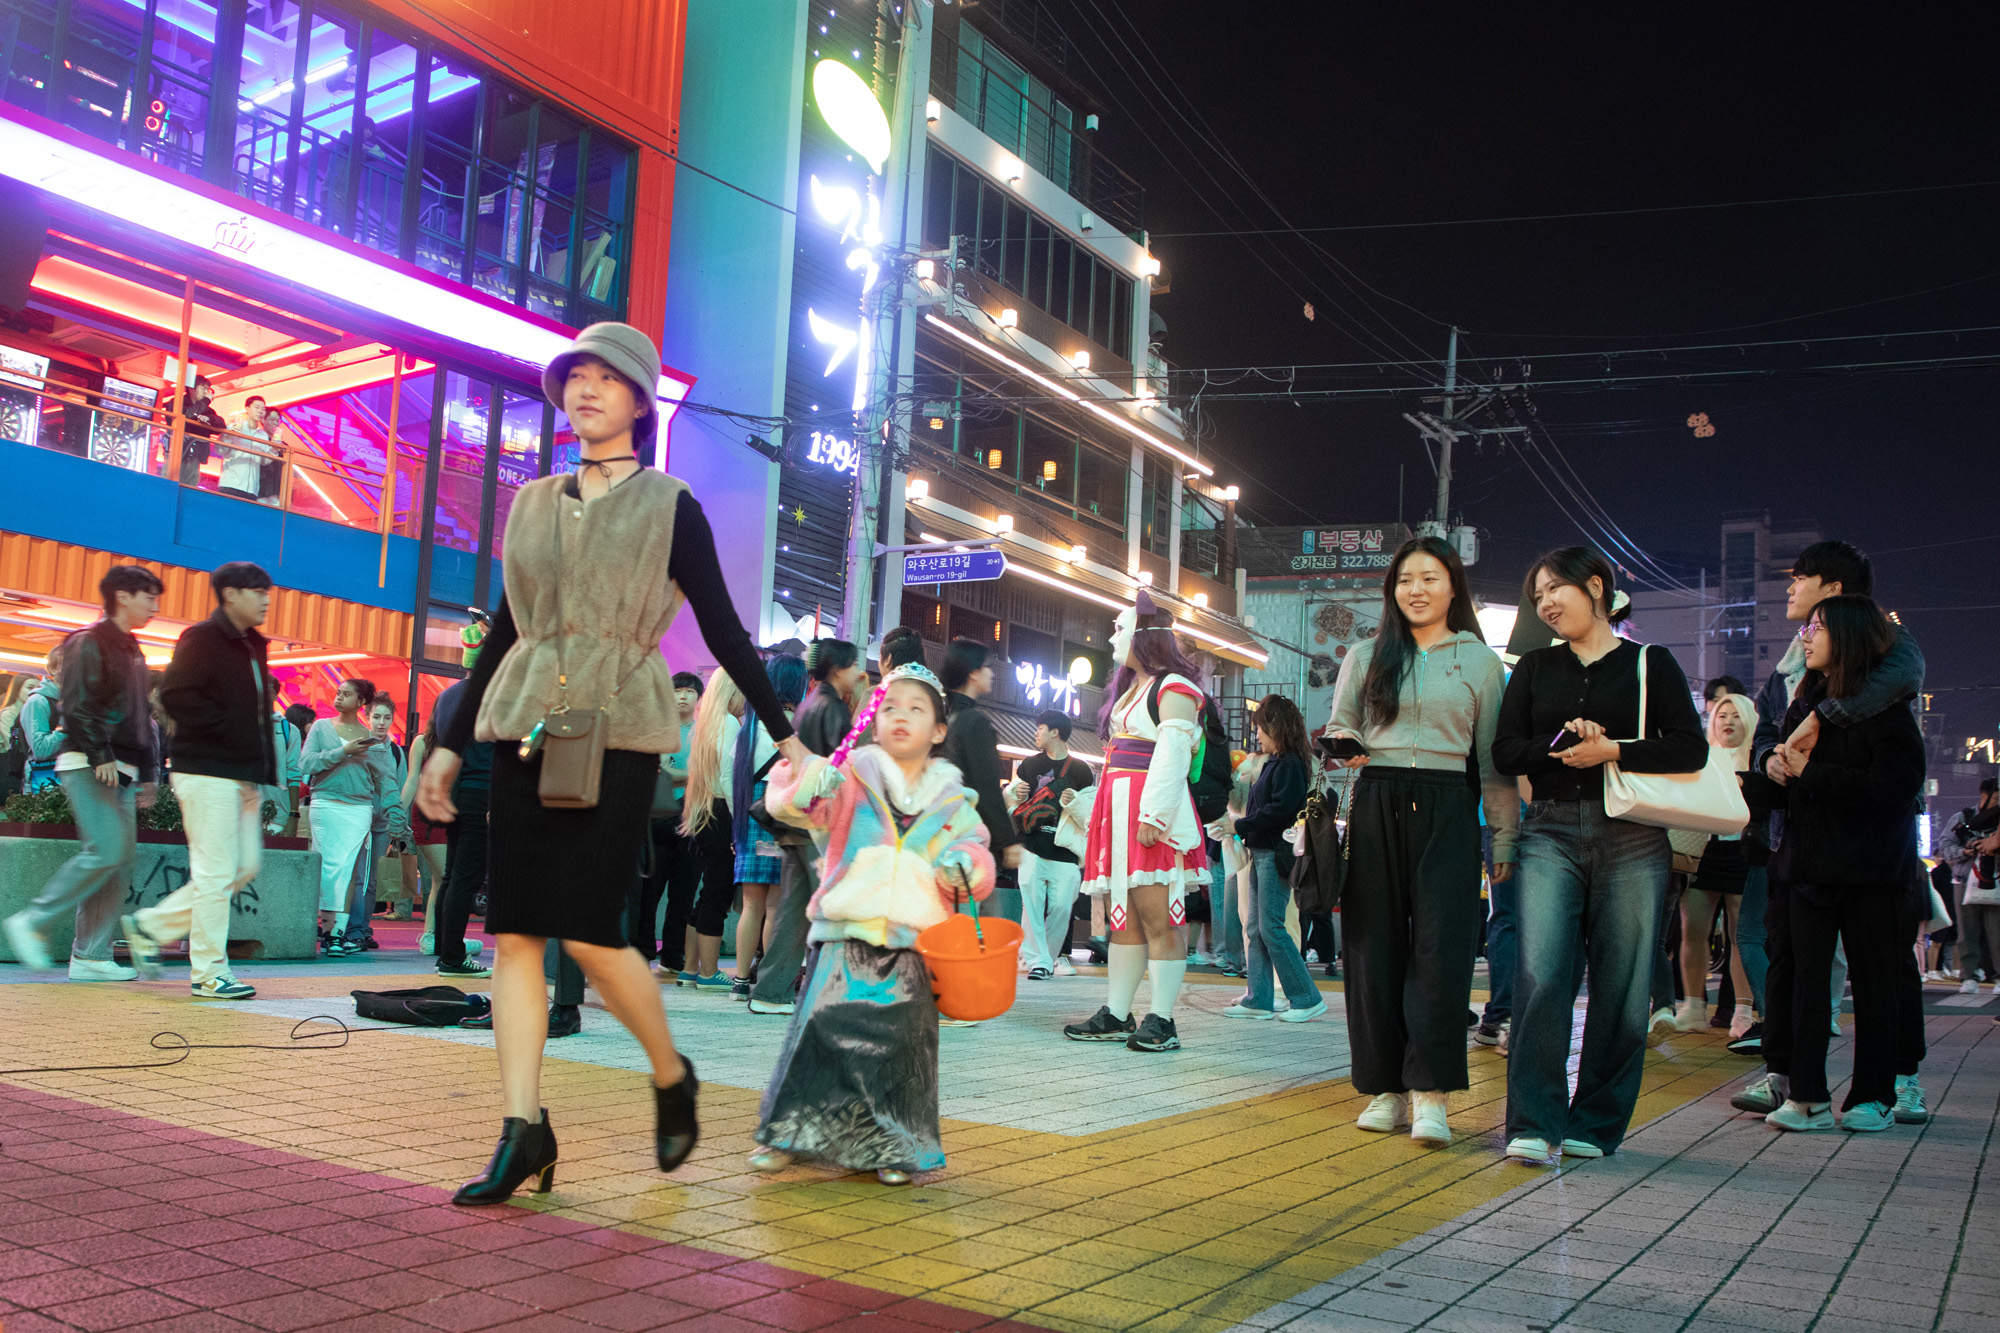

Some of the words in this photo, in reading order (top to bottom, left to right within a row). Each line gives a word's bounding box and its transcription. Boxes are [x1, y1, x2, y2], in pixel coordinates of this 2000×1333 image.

[807, 430, 861, 477] 1994
[1319, 530, 1384, 553] 부동산
[907, 555, 971, 571] 와우산로19길
[1291, 555, 1337, 570] 상가전문
[907, 573, 945, 582] Wausan-ro
[947, 571, 967, 580] 19-gil
